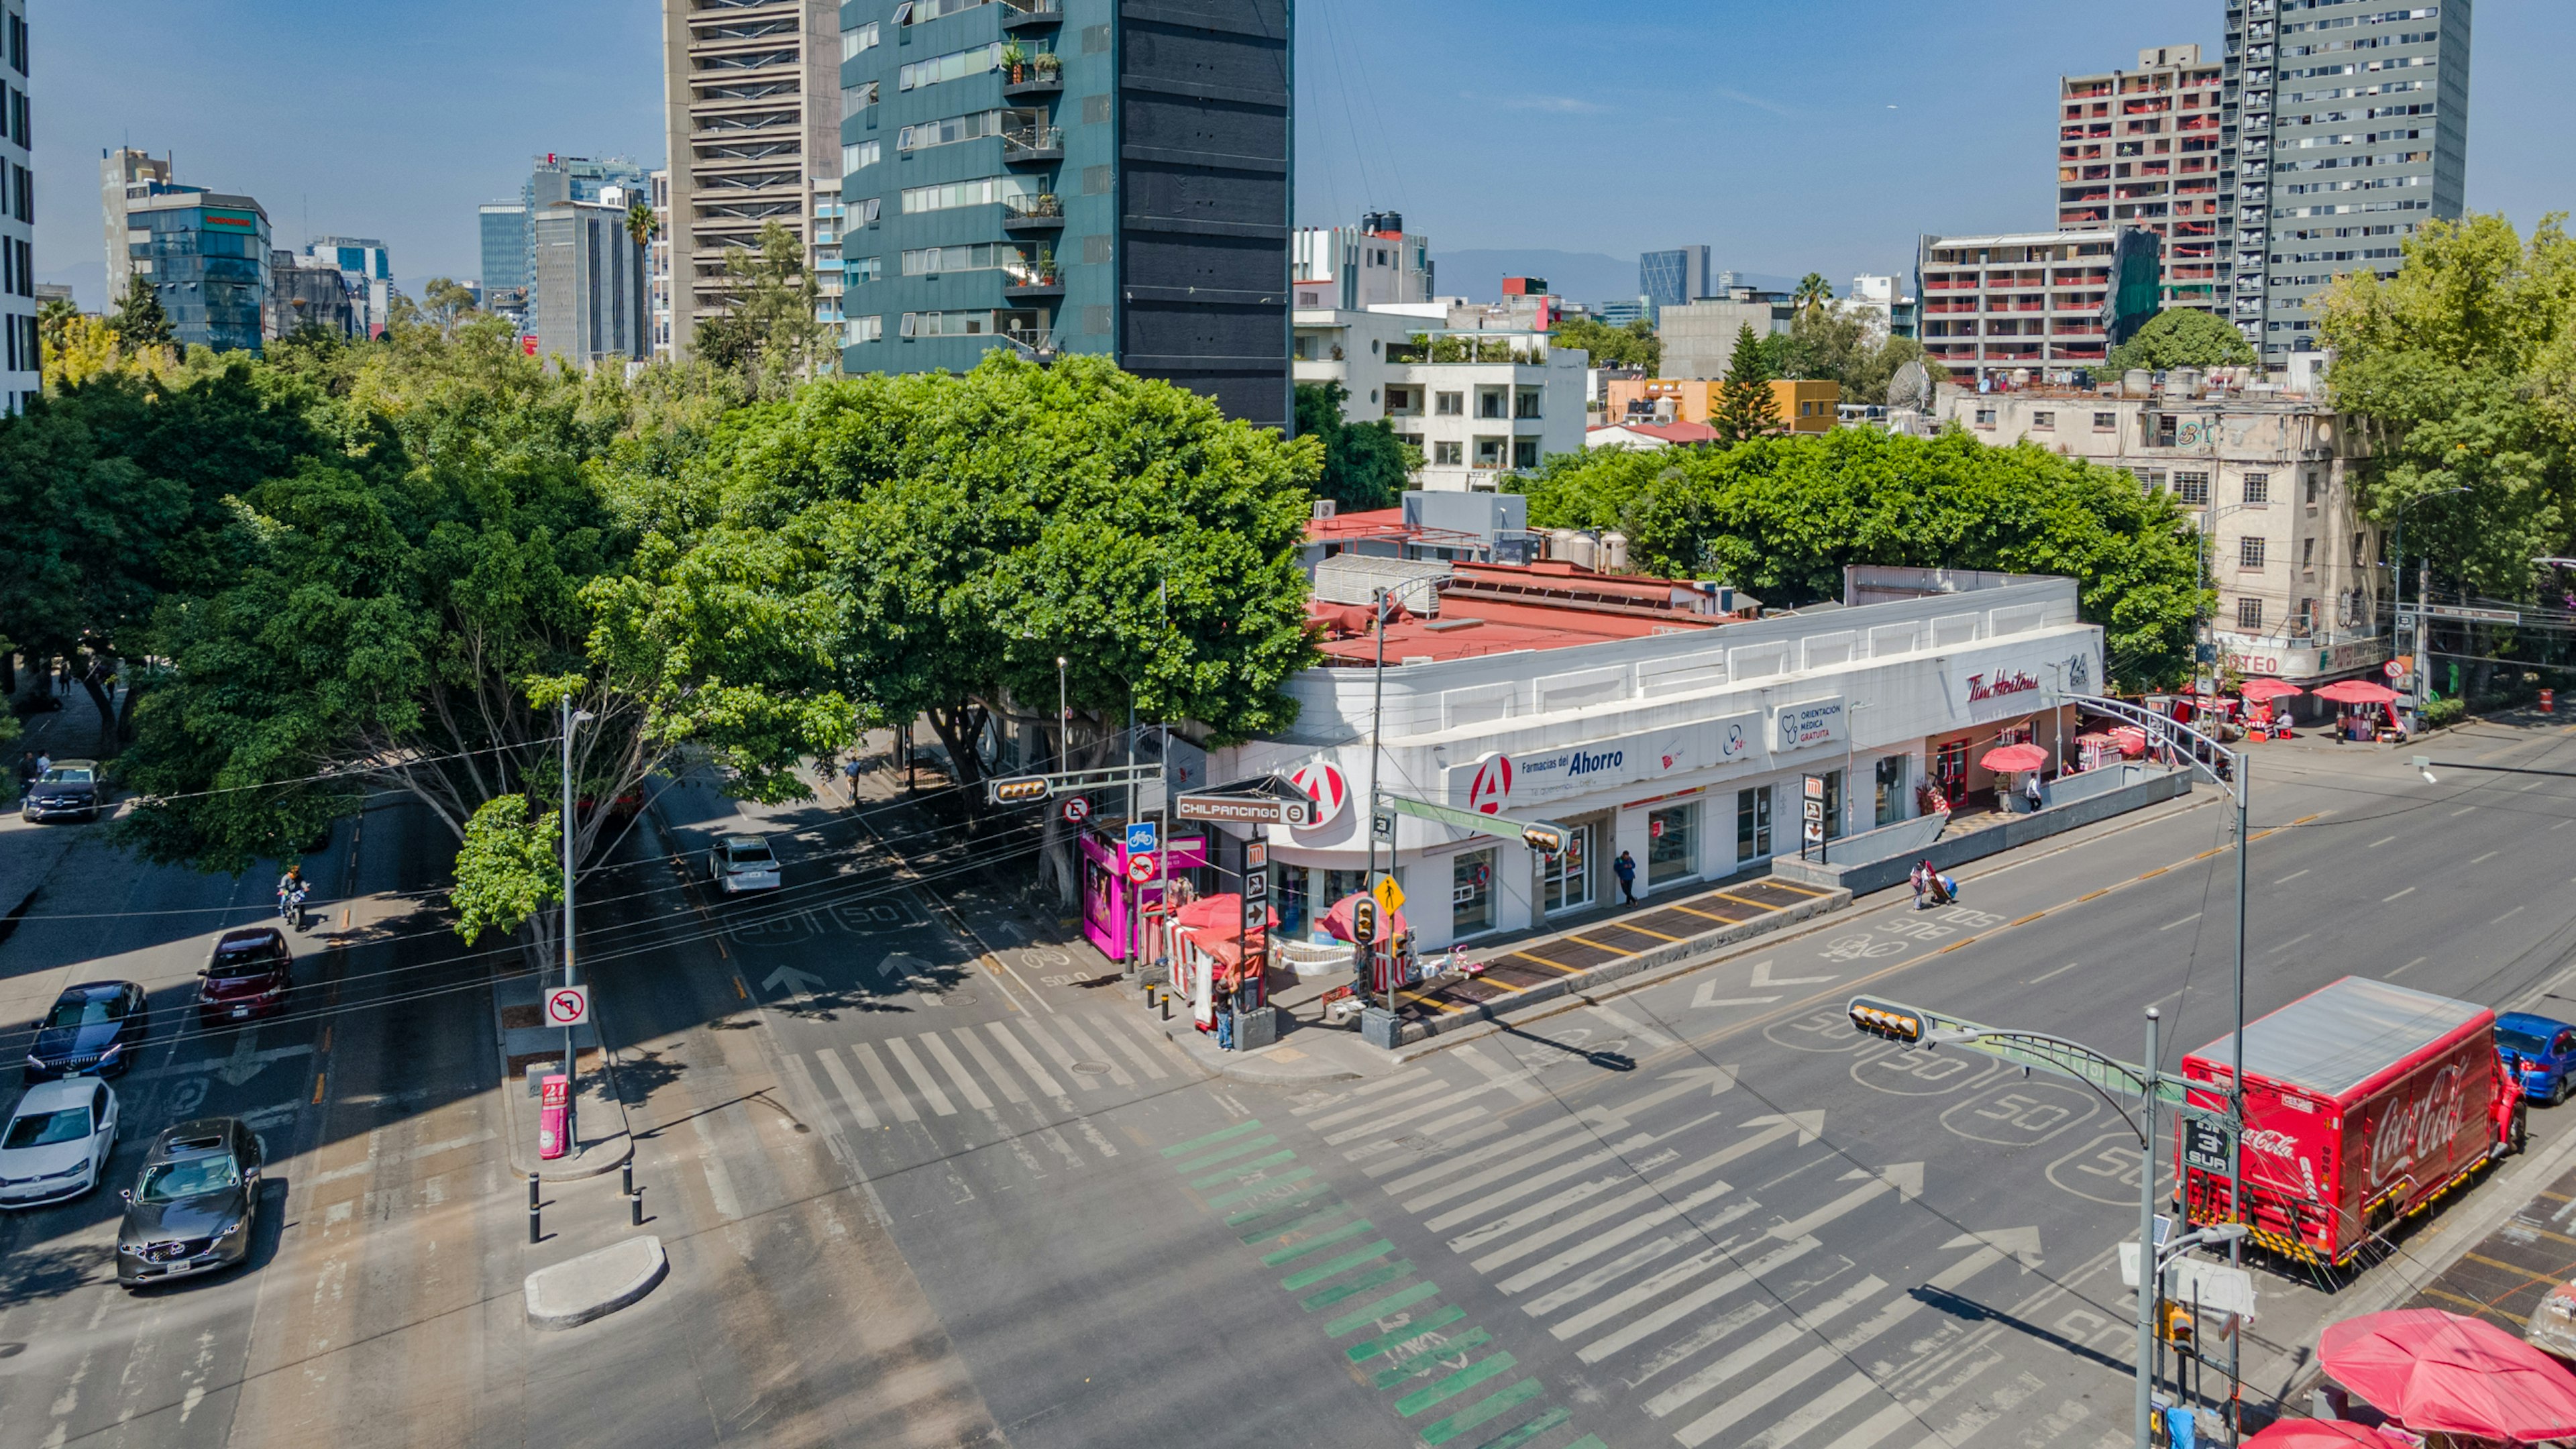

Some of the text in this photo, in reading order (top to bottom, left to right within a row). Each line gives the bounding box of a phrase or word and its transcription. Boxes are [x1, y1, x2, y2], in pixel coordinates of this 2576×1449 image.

[1967, 667, 2039, 702] Tim Hortons
[1801, 704, 1841, 720] ORIENTACIÓN
[1801, 719, 1823, 731] MÉDICA
[1801, 729, 1829, 742] GRATUITA
[1522, 750, 1623, 777] Farmacias del Ahorro
[1181, 803, 1301, 818] CHILPANCINGO 9
[1377, 819, 1387, 830] 3
[1875, 918, 1958, 940] BUS
[1878, 1048, 1969, 1081] 50
[1975, 1093, 2070, 1131] 50
[2198, 1133, 2219, 1153] 3
[2189, 1150, 2226, 1171] SUR
